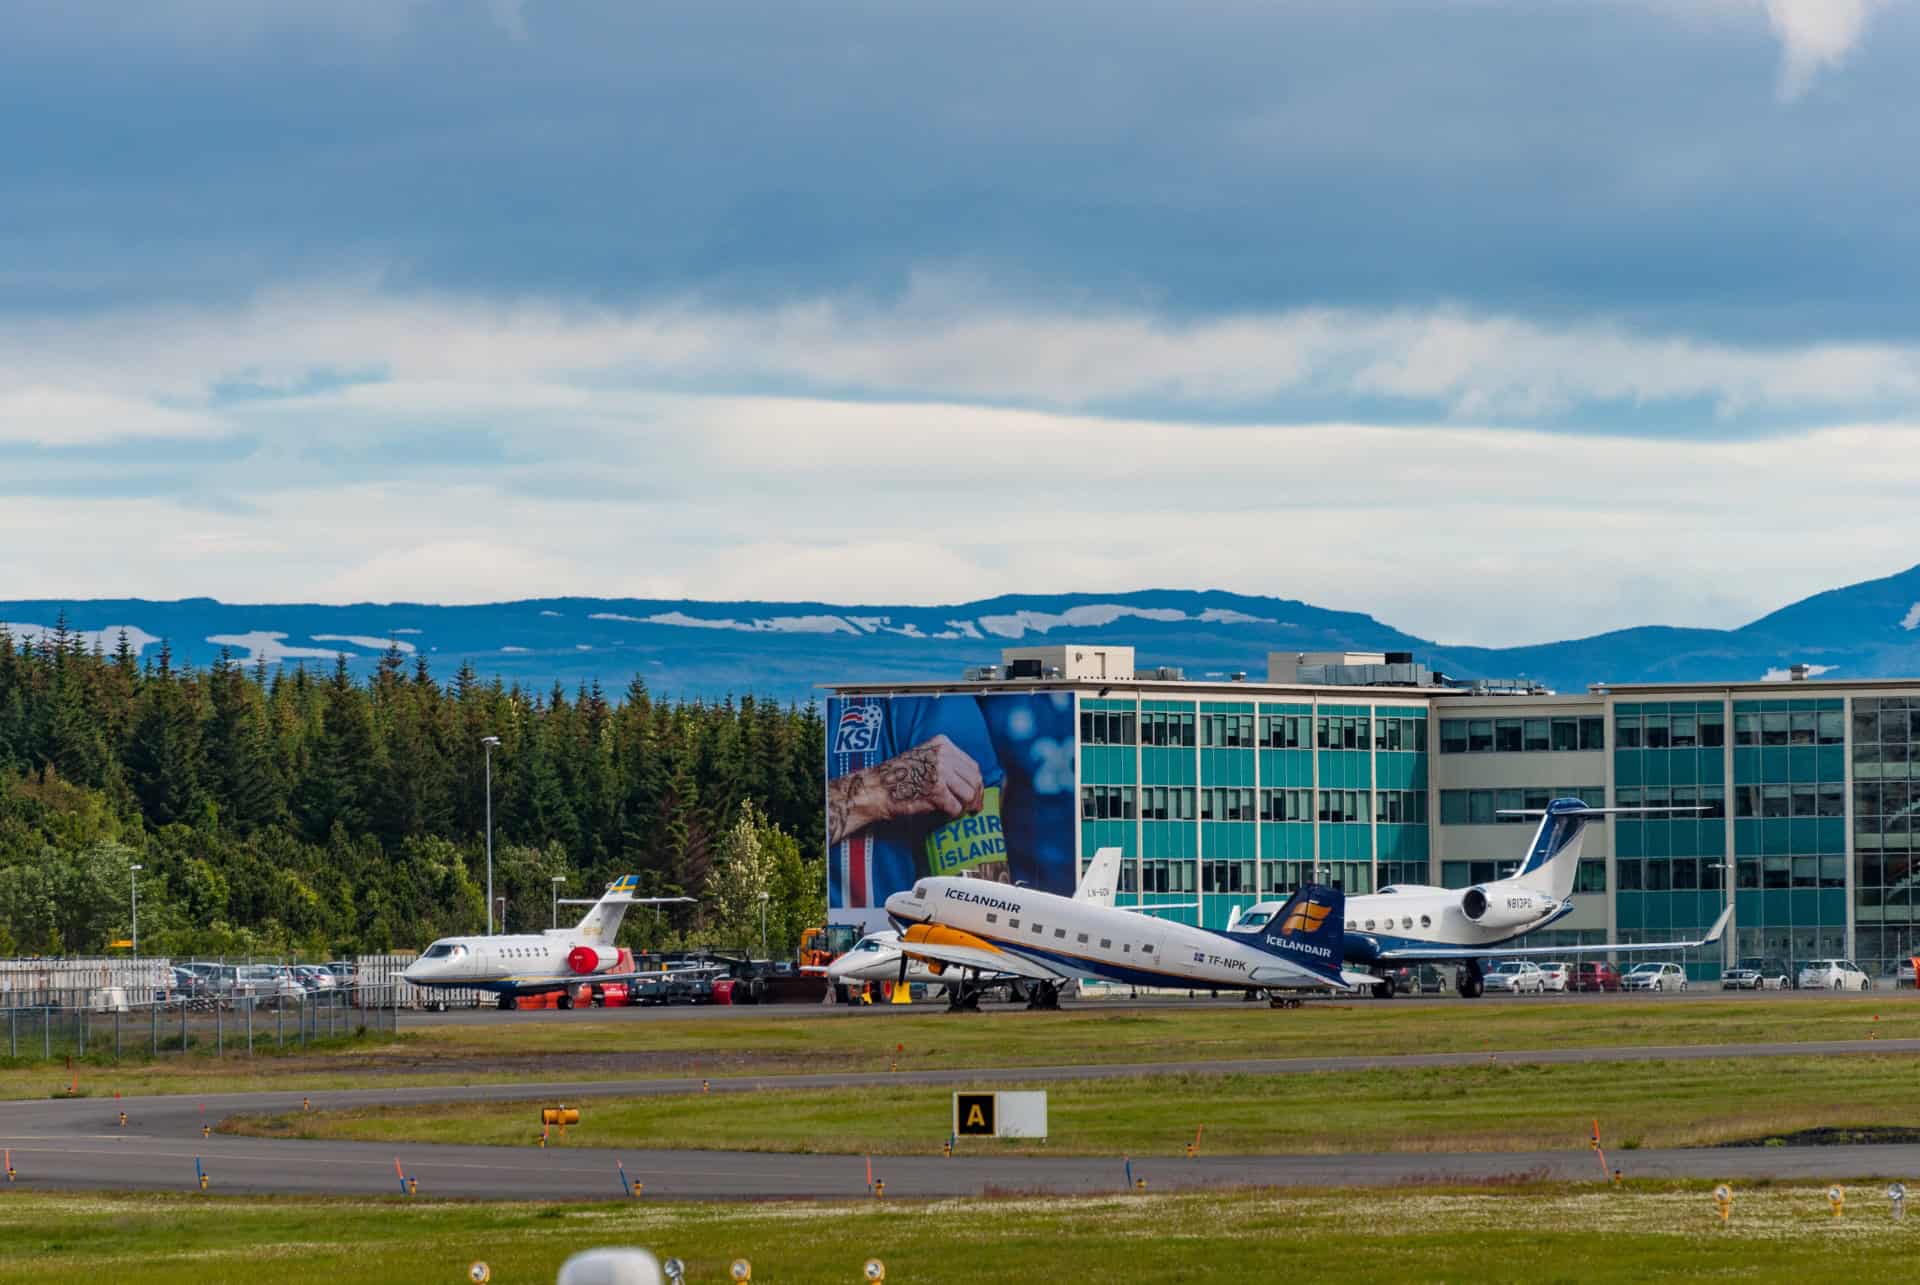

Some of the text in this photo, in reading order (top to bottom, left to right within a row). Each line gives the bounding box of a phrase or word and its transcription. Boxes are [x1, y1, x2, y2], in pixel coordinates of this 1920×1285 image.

[933, 815, 1004, 850] FYRIR
[944, 887, 1022, 914] ICELANDAIR
[1266, 934, 1332, 958] ICELANDAIR
[1208, 954, 1246, 971] TF-NPK
[967, 1103, 985, 1127] A
